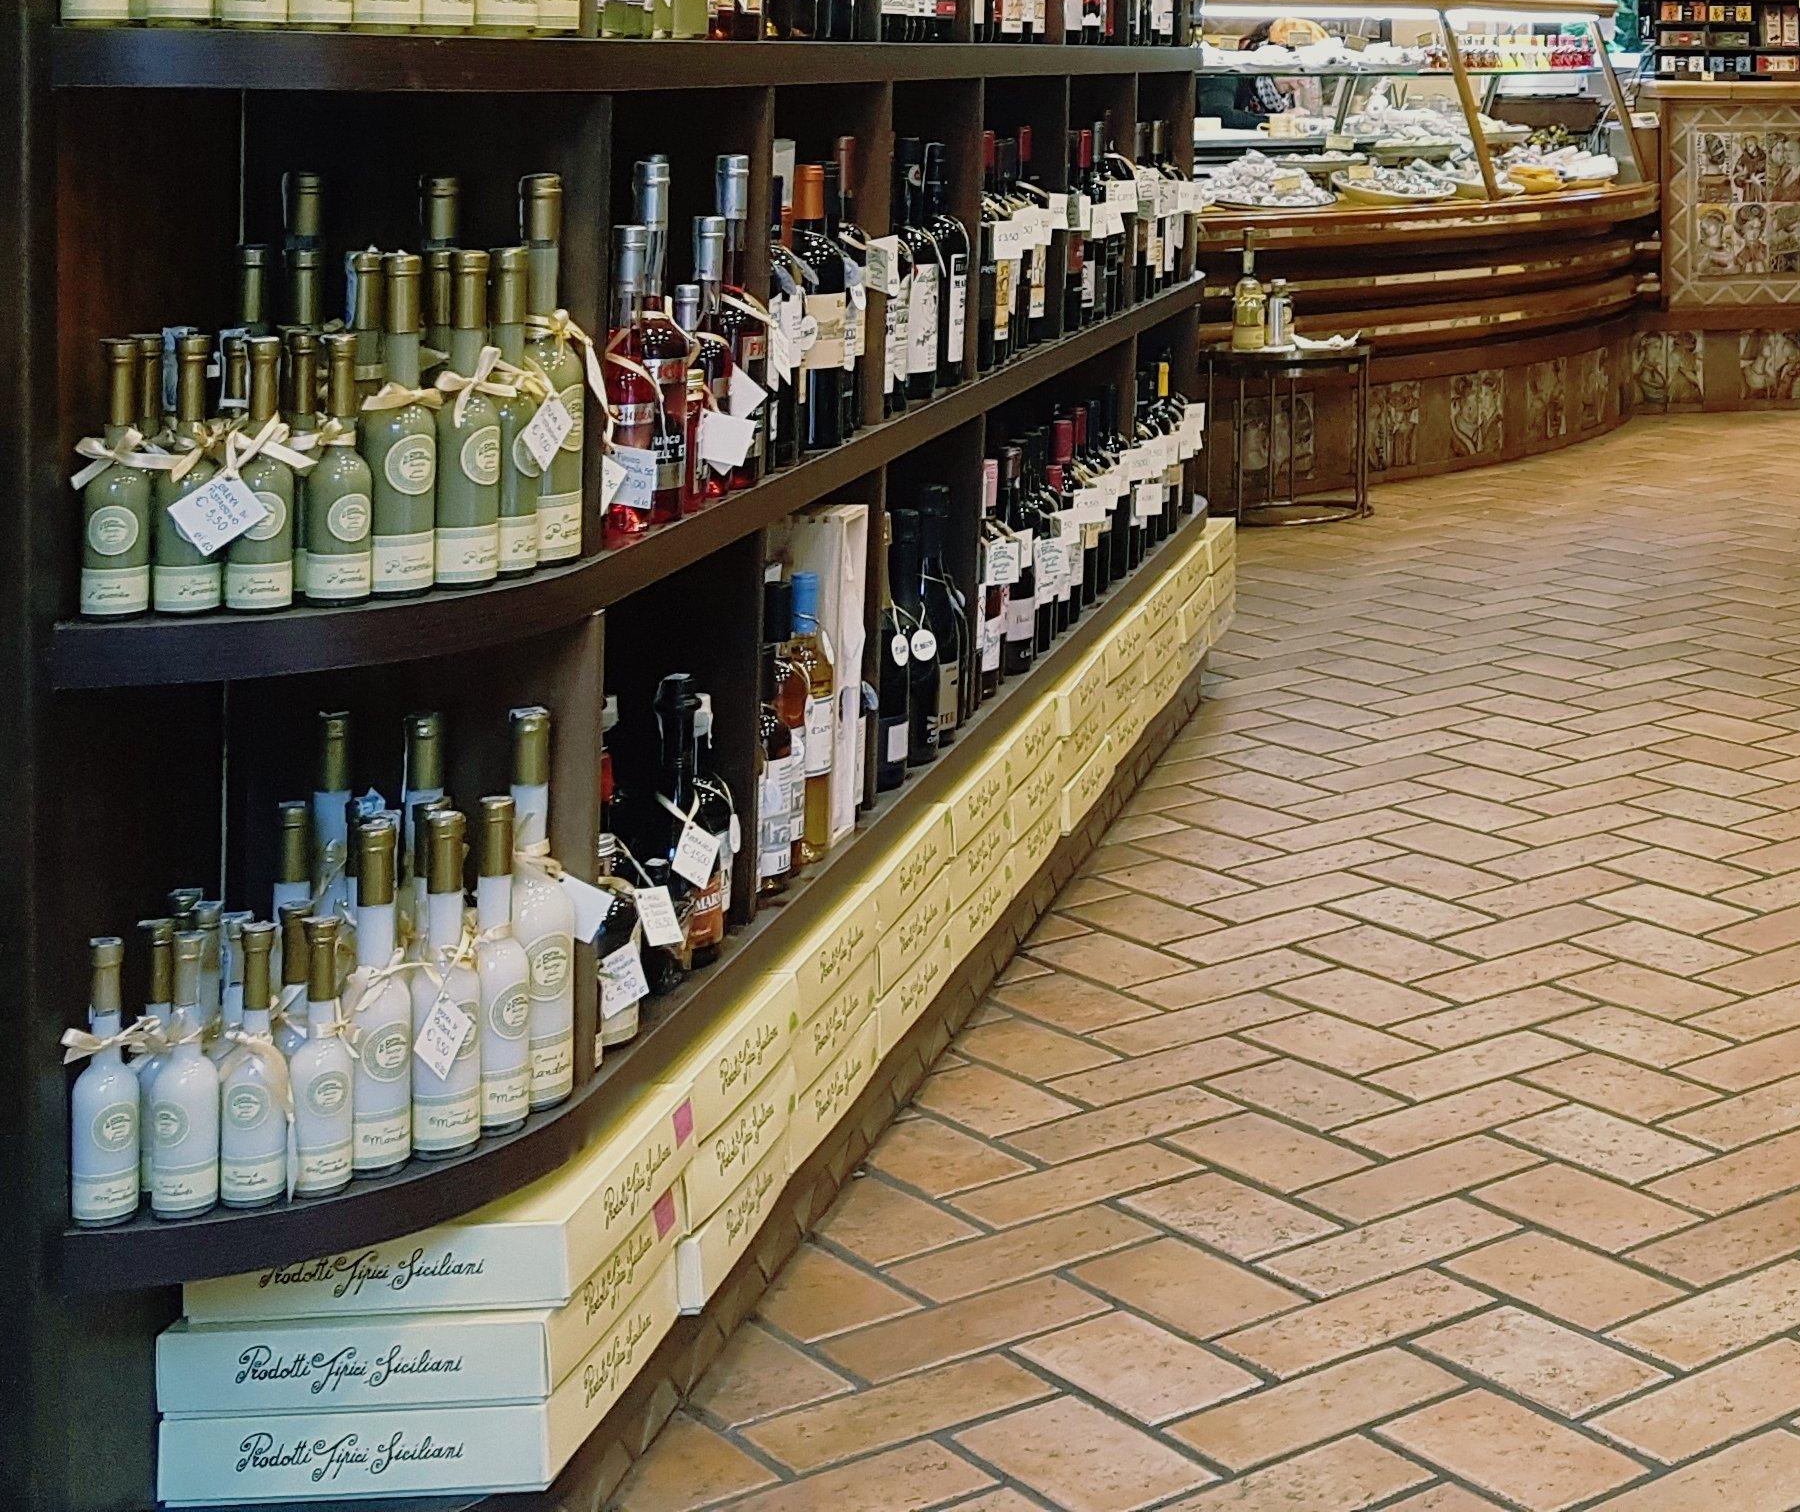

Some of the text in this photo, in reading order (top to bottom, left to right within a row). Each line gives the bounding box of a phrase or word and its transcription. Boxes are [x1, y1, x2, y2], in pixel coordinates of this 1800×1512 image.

[333, 1250, 389, 1298] Tipici
[391, 1248, 485, 1290] Siciliani
[235, 1344, 463, 1394] Prodotti Tipici Siciliani
[236, 1431, 464, 1482] Prodotti Tipici Siciliani
